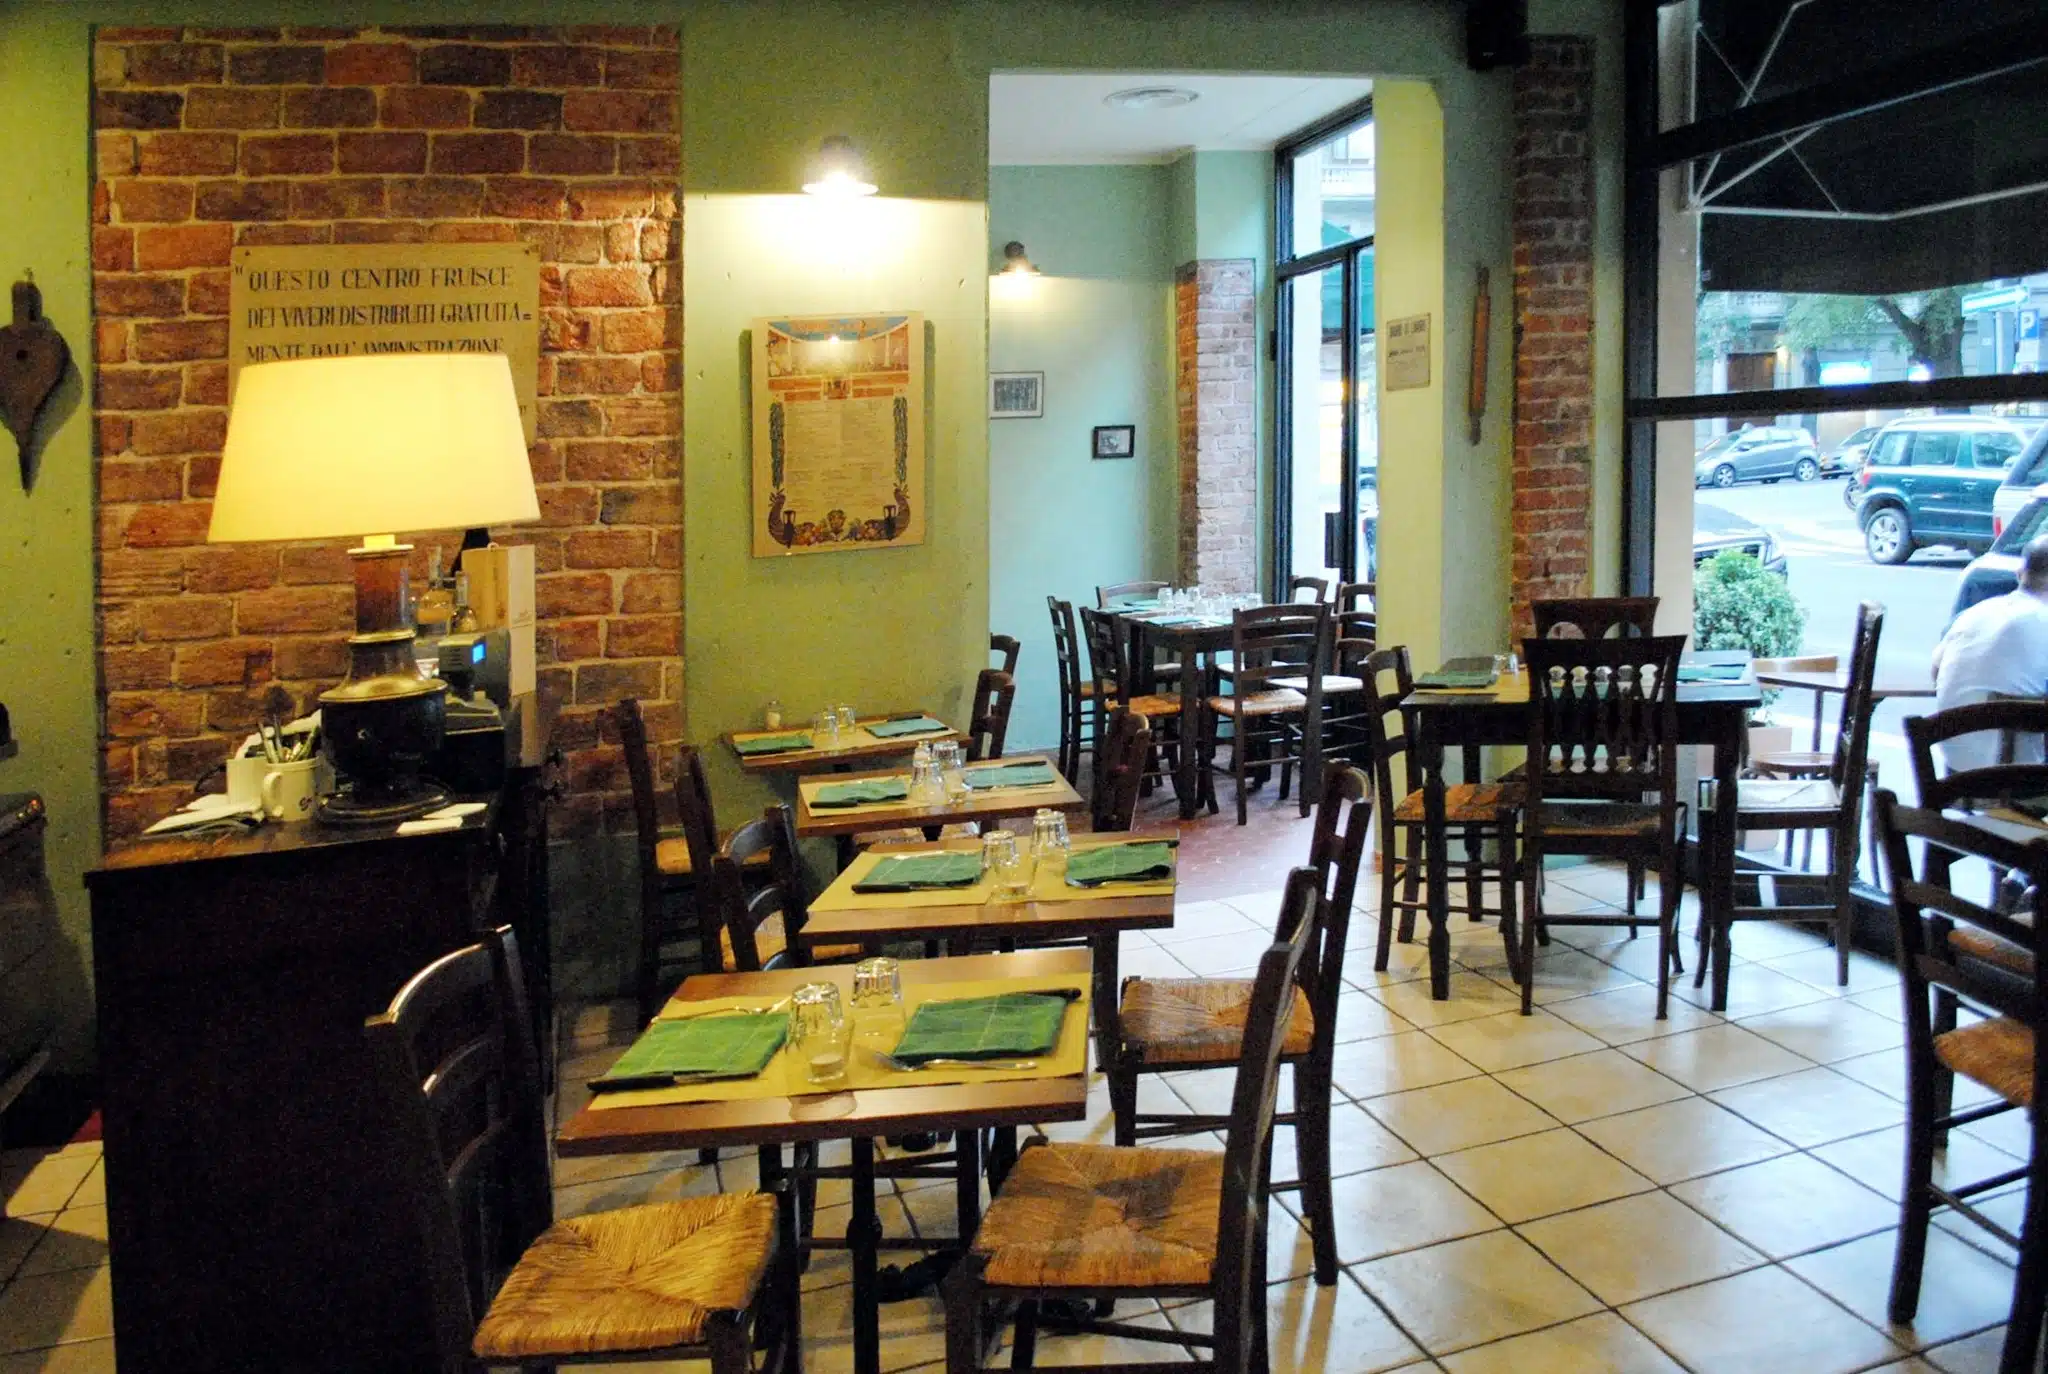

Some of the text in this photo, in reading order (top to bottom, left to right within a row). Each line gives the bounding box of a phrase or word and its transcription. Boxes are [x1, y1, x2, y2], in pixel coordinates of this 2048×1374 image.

[341, 267, 421, 289] CENTRO
[431, 265, 513, 288] FRUISCE
[247, 306, 275, 329] DEI
[280, 304, 335, 328] VIVERI
[2020, 311, 2036, 337] P
